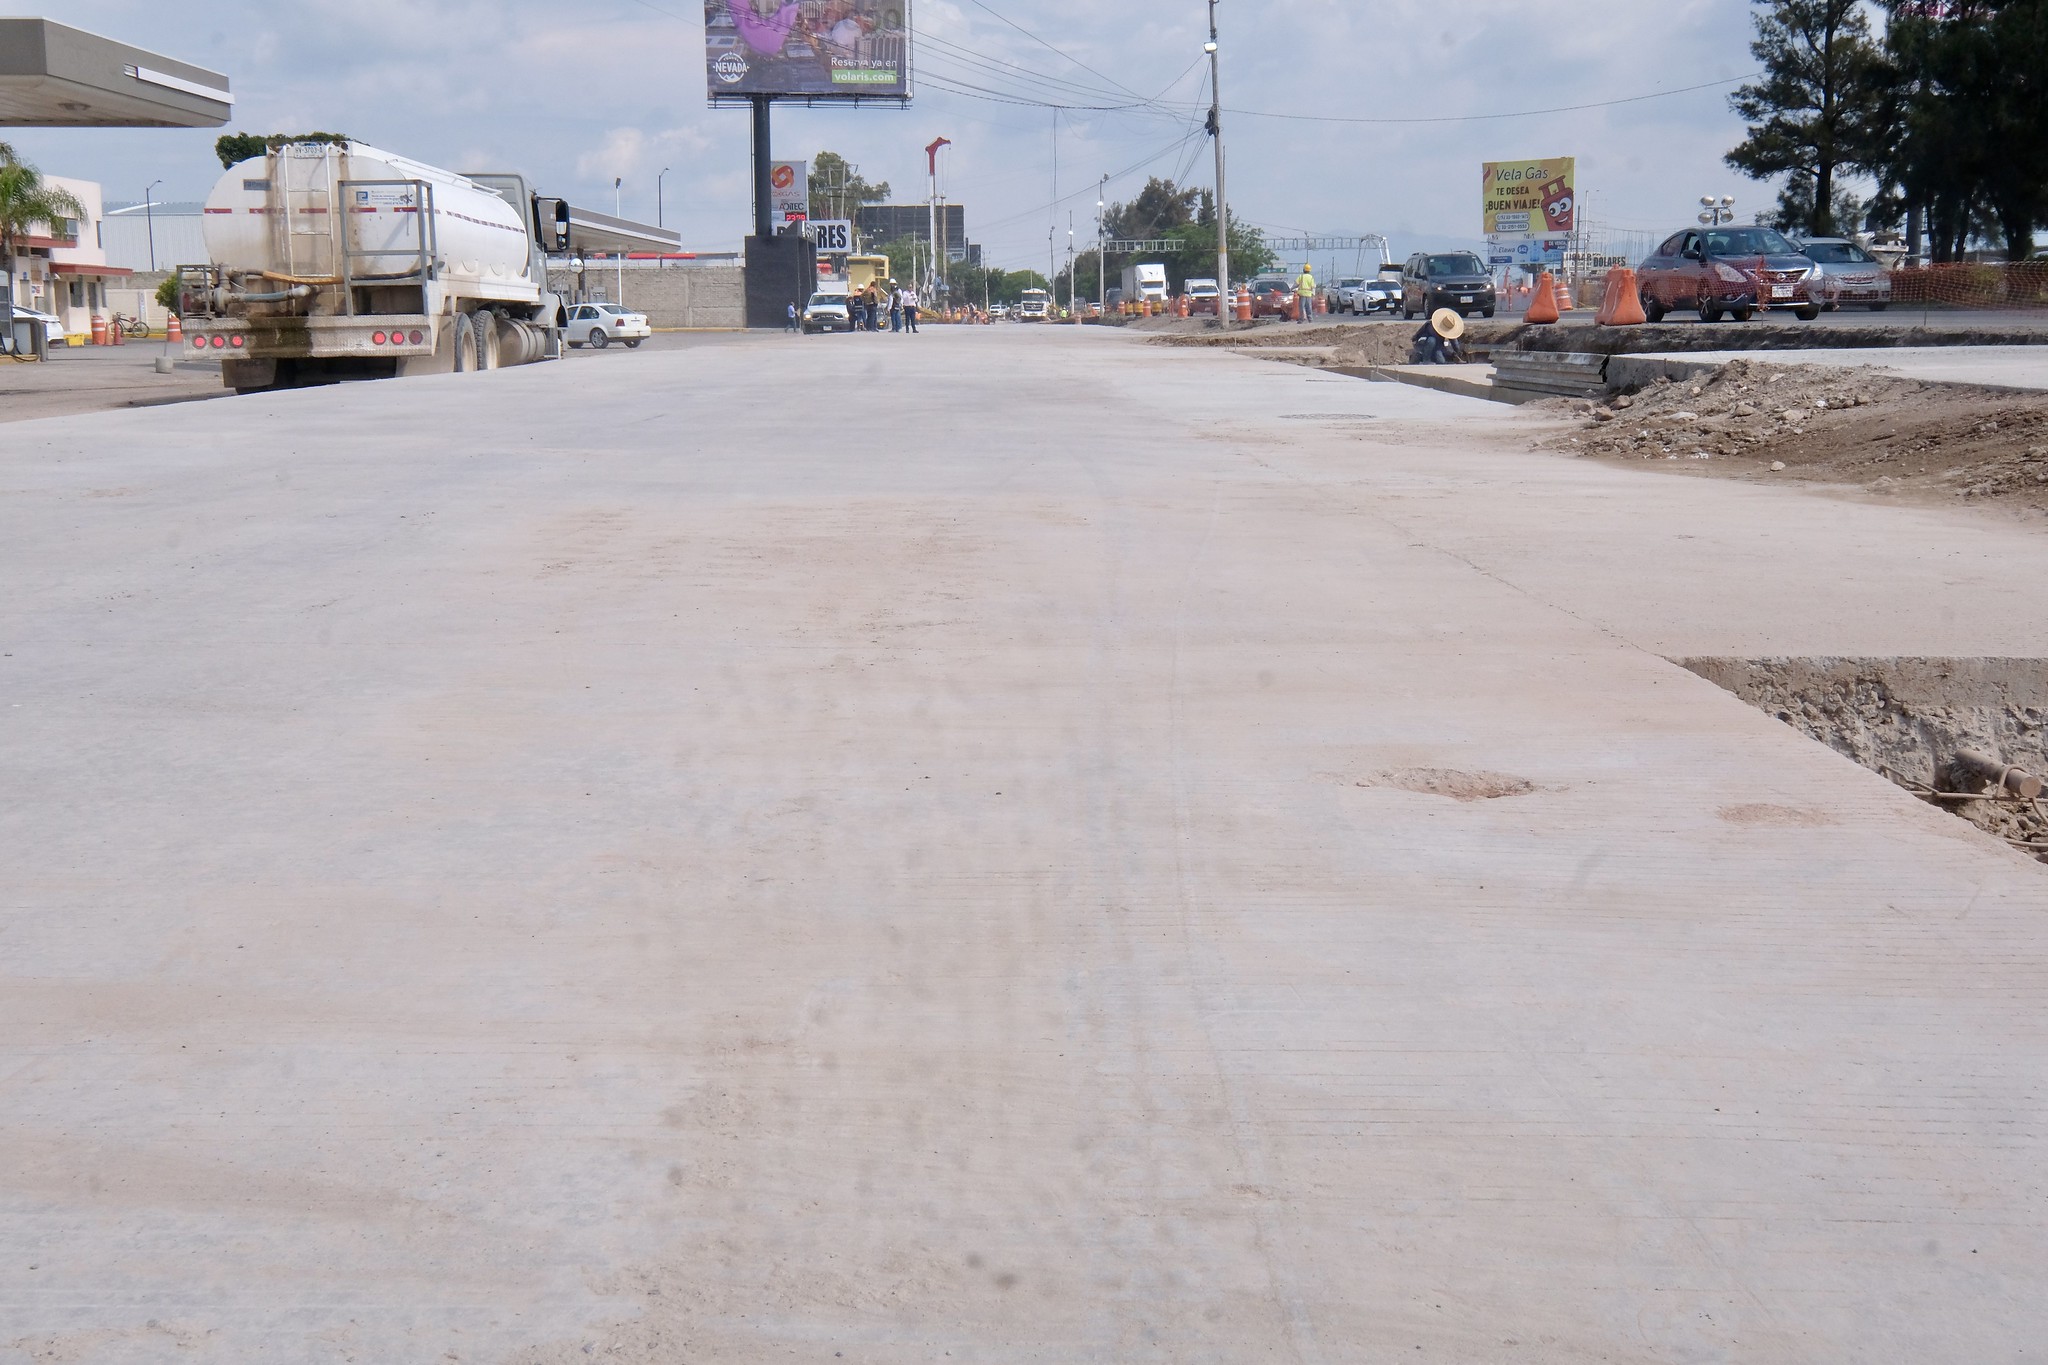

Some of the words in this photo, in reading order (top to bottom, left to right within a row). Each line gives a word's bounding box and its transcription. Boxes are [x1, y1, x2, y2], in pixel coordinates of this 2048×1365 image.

[715, 61, 748, 73] NEVADA
[831, 57, 869, 67] Reserva
[871, 59, 882, 69] ya
[885, 59, 897, 67] en
[834, 72, 894, 81] volaris.com
[1496, 168, 1522, 181] Vela
[1525, 166, 1549, 180] Gas
[1496, 187, 1505, 196] TE
[1506, 186, 1530, 195] DESEA
[1486, 200, 1511, 214] ¡BUEN
[1513, 198, 1541, 210] VIAJE!
[1593, 256, 1626, 268] DOLARES
